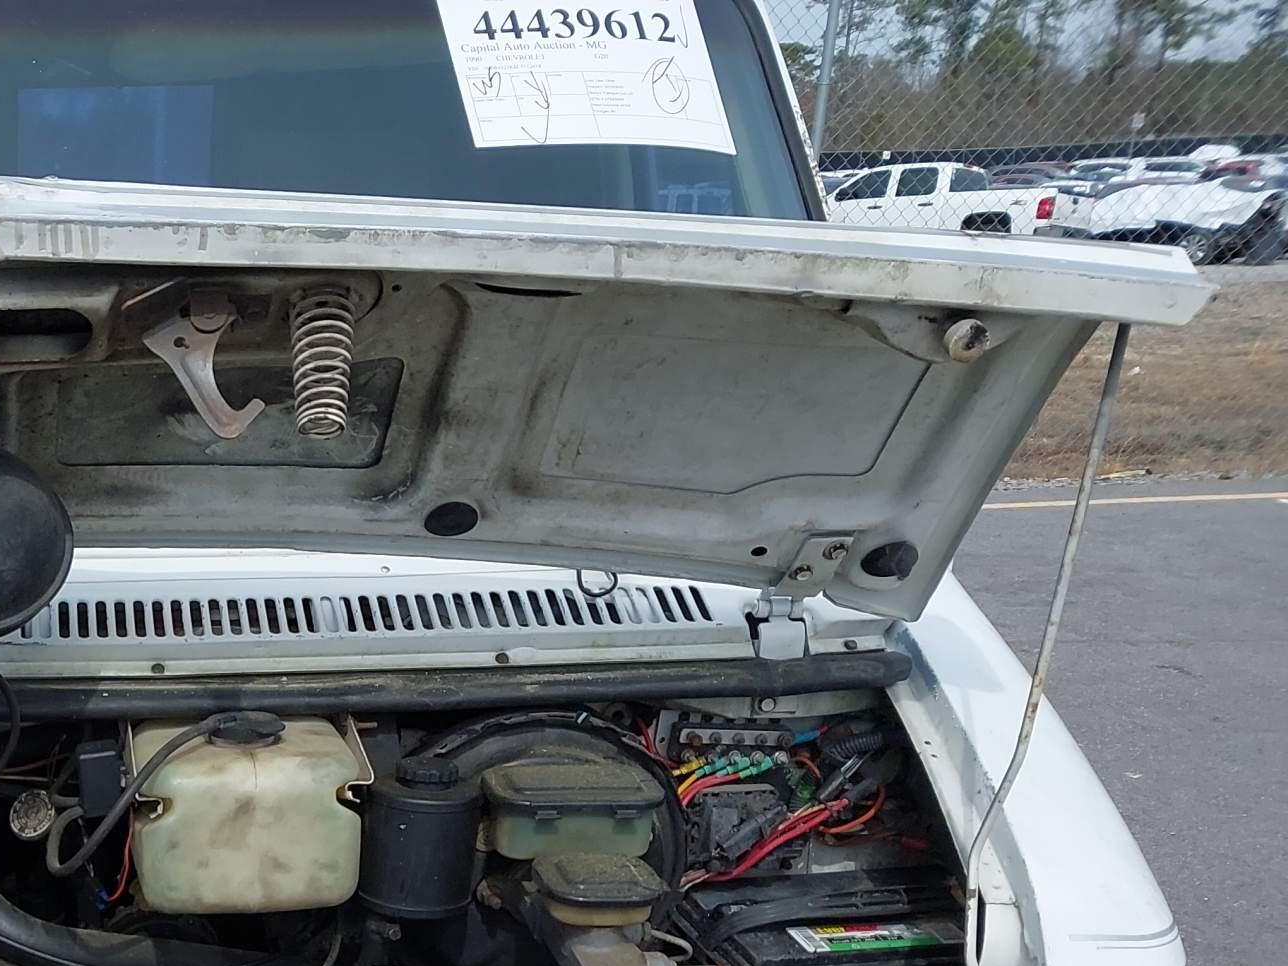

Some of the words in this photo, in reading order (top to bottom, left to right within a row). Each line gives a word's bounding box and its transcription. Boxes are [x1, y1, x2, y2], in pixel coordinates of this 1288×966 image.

[473, 8, 676, 43] 44439612
[460, 42, 500, 54] Capital
[504, 41, 530, 51] Auto
[534, 40, 576, 50] Auction
[586, 41, 607, 50] MG
